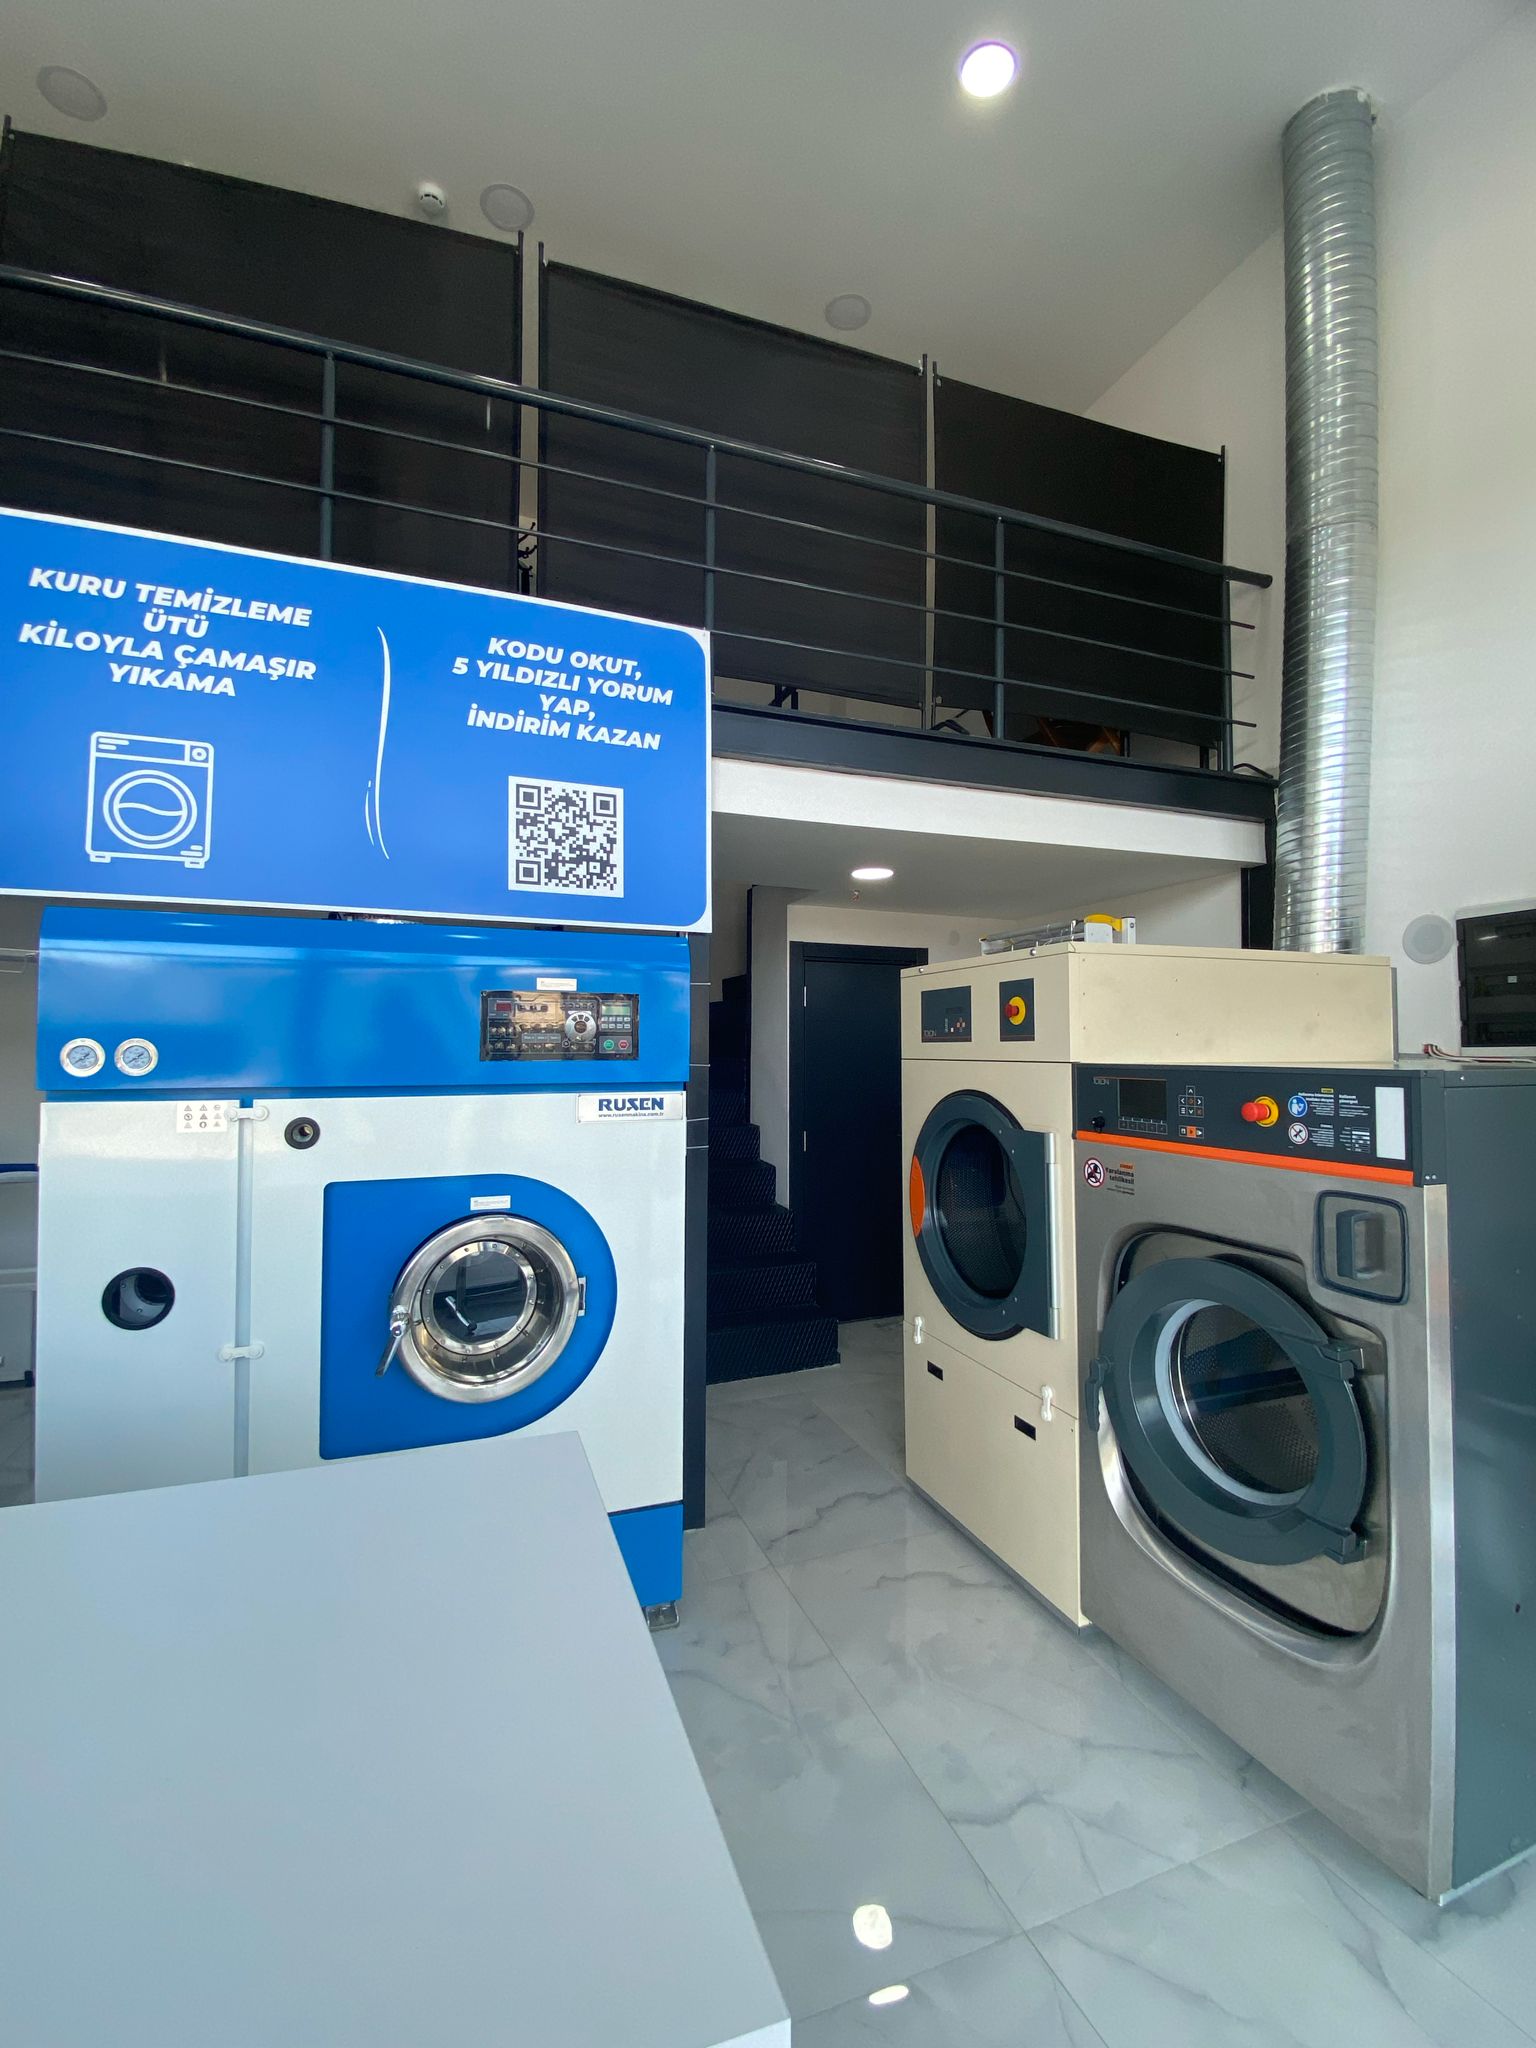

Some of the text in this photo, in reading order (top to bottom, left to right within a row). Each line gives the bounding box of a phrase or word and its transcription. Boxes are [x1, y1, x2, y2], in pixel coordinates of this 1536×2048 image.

[29, 567, 313, 627] KURU TEMİZLEME
[143, 607, 209, 638] ÜTÜ
[19, 620, 317, 681] KİLOYLA ÇAMAŞIR
[487, 637, 642, 681] KODU OKUT,
[109, 662, 236, 697] YIKAMA
[452, 656, 673, 706] 5 YILDIZLI YORUM
[467, 703, 661, 750] İNDİRİM KAZAN
[539, 693, 596, 721] YAP,
[598, 1097, 664, 1111] RUSEN
